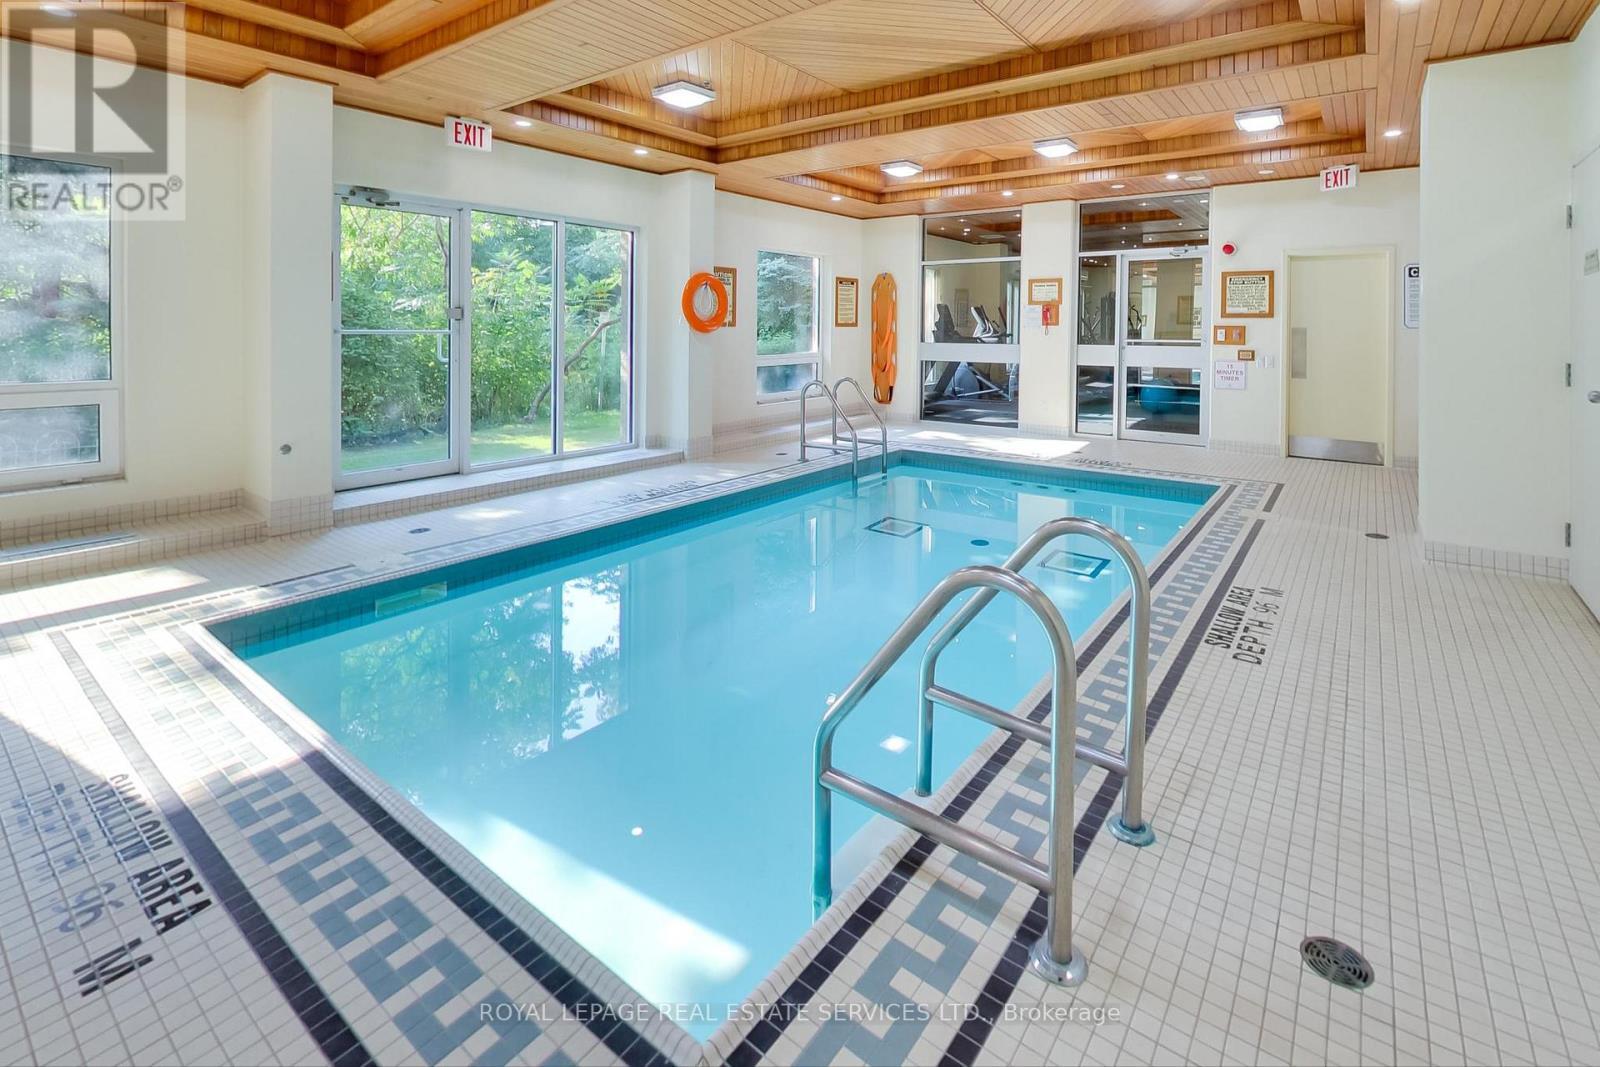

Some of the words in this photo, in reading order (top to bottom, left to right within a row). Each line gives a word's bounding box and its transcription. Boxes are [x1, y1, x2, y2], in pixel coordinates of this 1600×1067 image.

[454, 121, 486, 148] EXIT
[1325, 168, 1351, 189] EXIT
[1204, 605, 1246, 649] SHALLOW
[1225, 586, 1256, 608] AREA
[1232, 618, 1275, 665] DEPTH
[80, 773, 174, 865] SHALLOW
[127, 857, 213, 936] AREA
[73, 937, 154, 997] M
